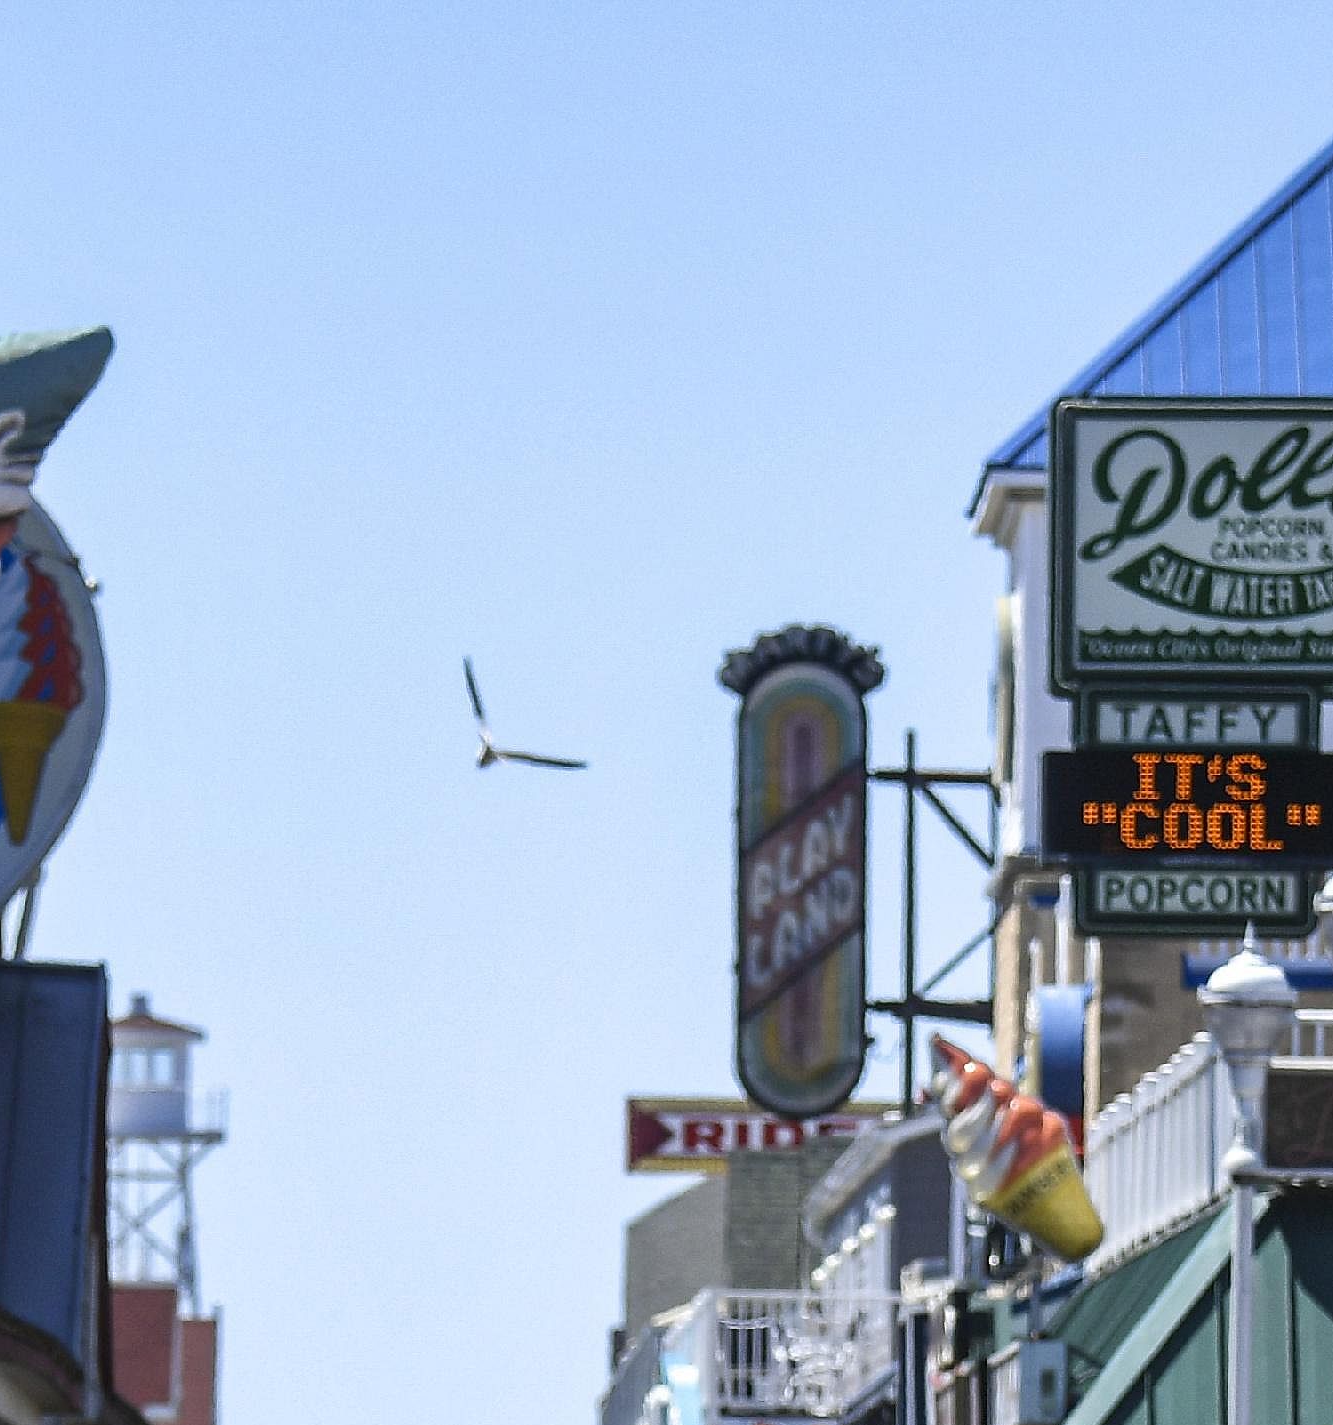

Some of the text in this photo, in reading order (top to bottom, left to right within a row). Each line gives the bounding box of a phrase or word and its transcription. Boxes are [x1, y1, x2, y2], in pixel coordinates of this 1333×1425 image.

[1211, 540, 1308, 561] CANDIES
[1218, 517, 1325, 538] POPCORN
[1139, 553, 1206, 602] SALT
[1210, 571, 1295, 615] WATER
[1115, 705, 1278, 743] TAFFY
[1132, 752, 1267, 800] IT'S
[1082, 802, 1322, 851] "COOL"
[747, 794, 855, 920] PLAY
[1103, 875, 1288, 912] POPCORN
[747, 868, 859, 986] LAND
